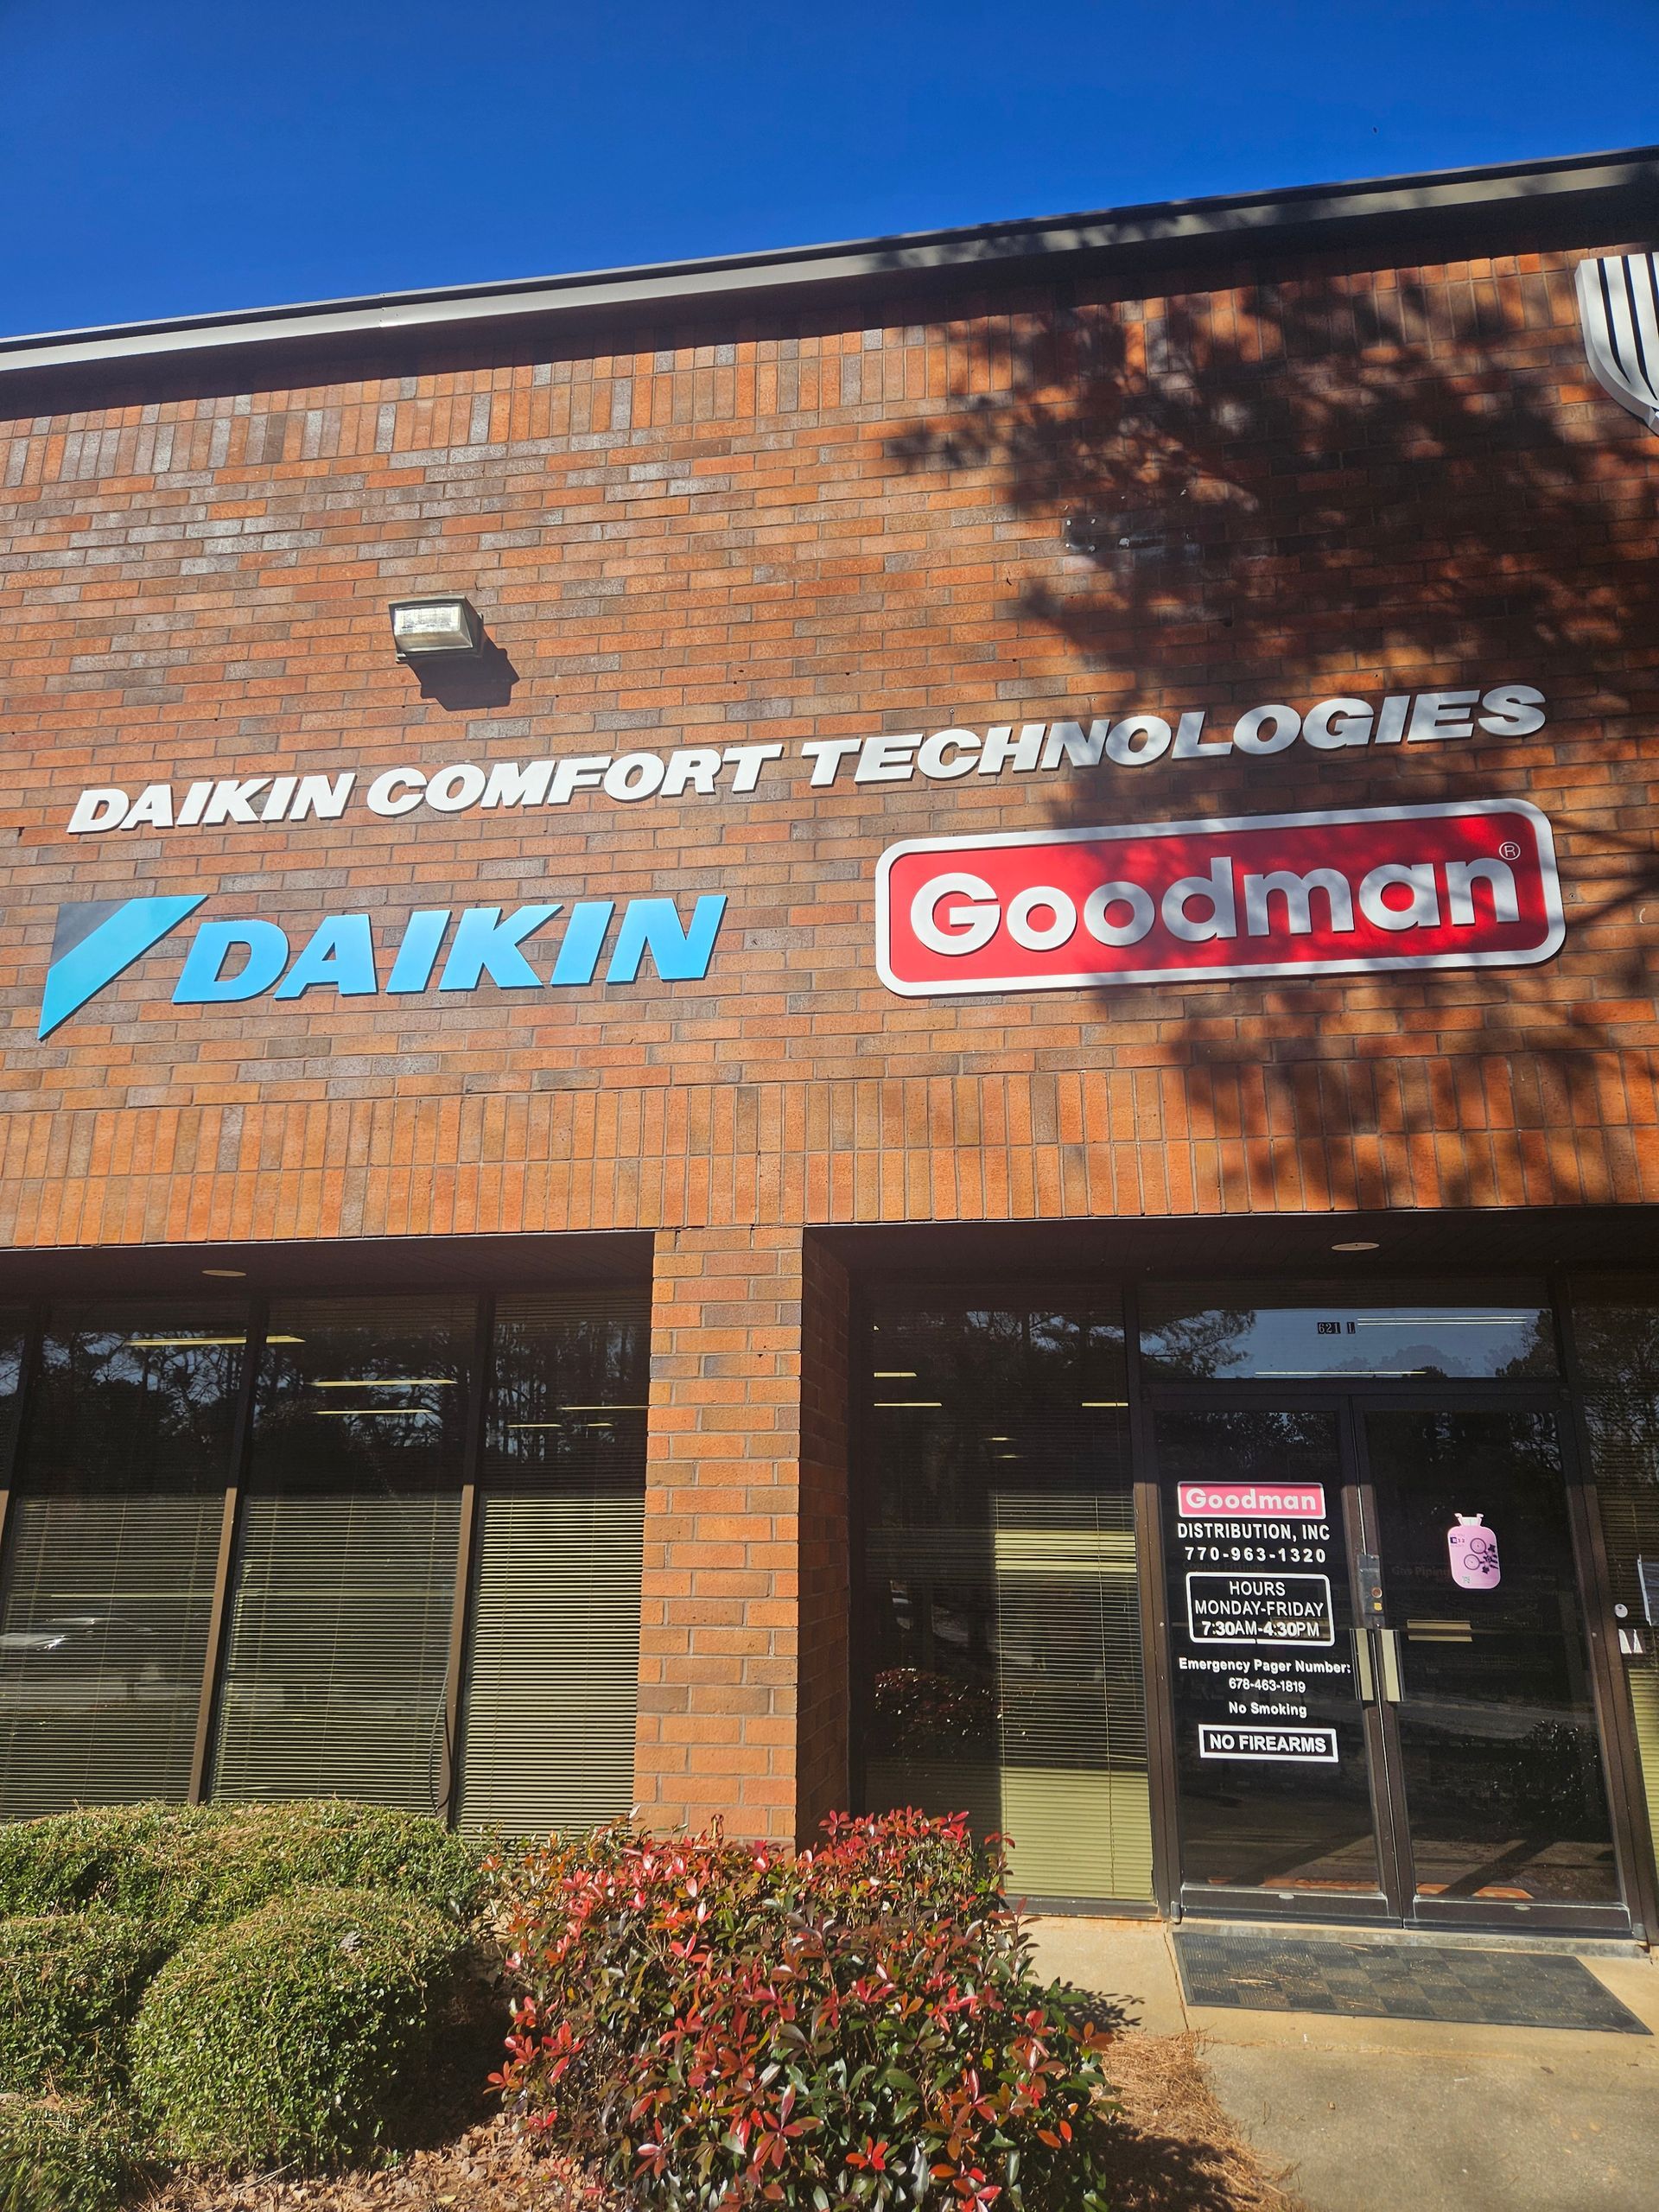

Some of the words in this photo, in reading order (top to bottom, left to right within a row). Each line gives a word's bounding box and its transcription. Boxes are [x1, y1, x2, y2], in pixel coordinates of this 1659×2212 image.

[67, 772, 356, 834] DAIKIN
[366, 744, 783, 814] COMFORT
[802, 685, 1546, 787] TECHNOLOGIES
[910, 856, 1521, 956] Goodman
[172, 894, 728, 1004] DAIKIN
[1186, 1488, 1316, 1510] Goodman
[1178, 1523, 1297, 1542] DISTRIBUTION,
[1303, 1524, 1330, 1541] INC
[1185, 1547, 1326, 1563] 770-963-1320
[1230, 1581, 1286, 1597] HOURS
[1195, 1600, 1324, 1617] MONDAY-FRIDAY
[1202, 1620, 1319, 1637] 7:30AM-4:30PM
[1178, 1657, 1250, 1673] Emergency
[1254, 1659, 1292, 1673] Pager
[1294, 1660, 1351, 1673] Number:
[1229, 1677, 1306, 1694] 678-463-1819
[1229, 1701, 1247, 1714] No
[1250, 1703, 1307, 1718] Smoking
[1210, 1733, 1235, 1750] NO
[1239, 1735, 1327, 1753] FIREARMS
